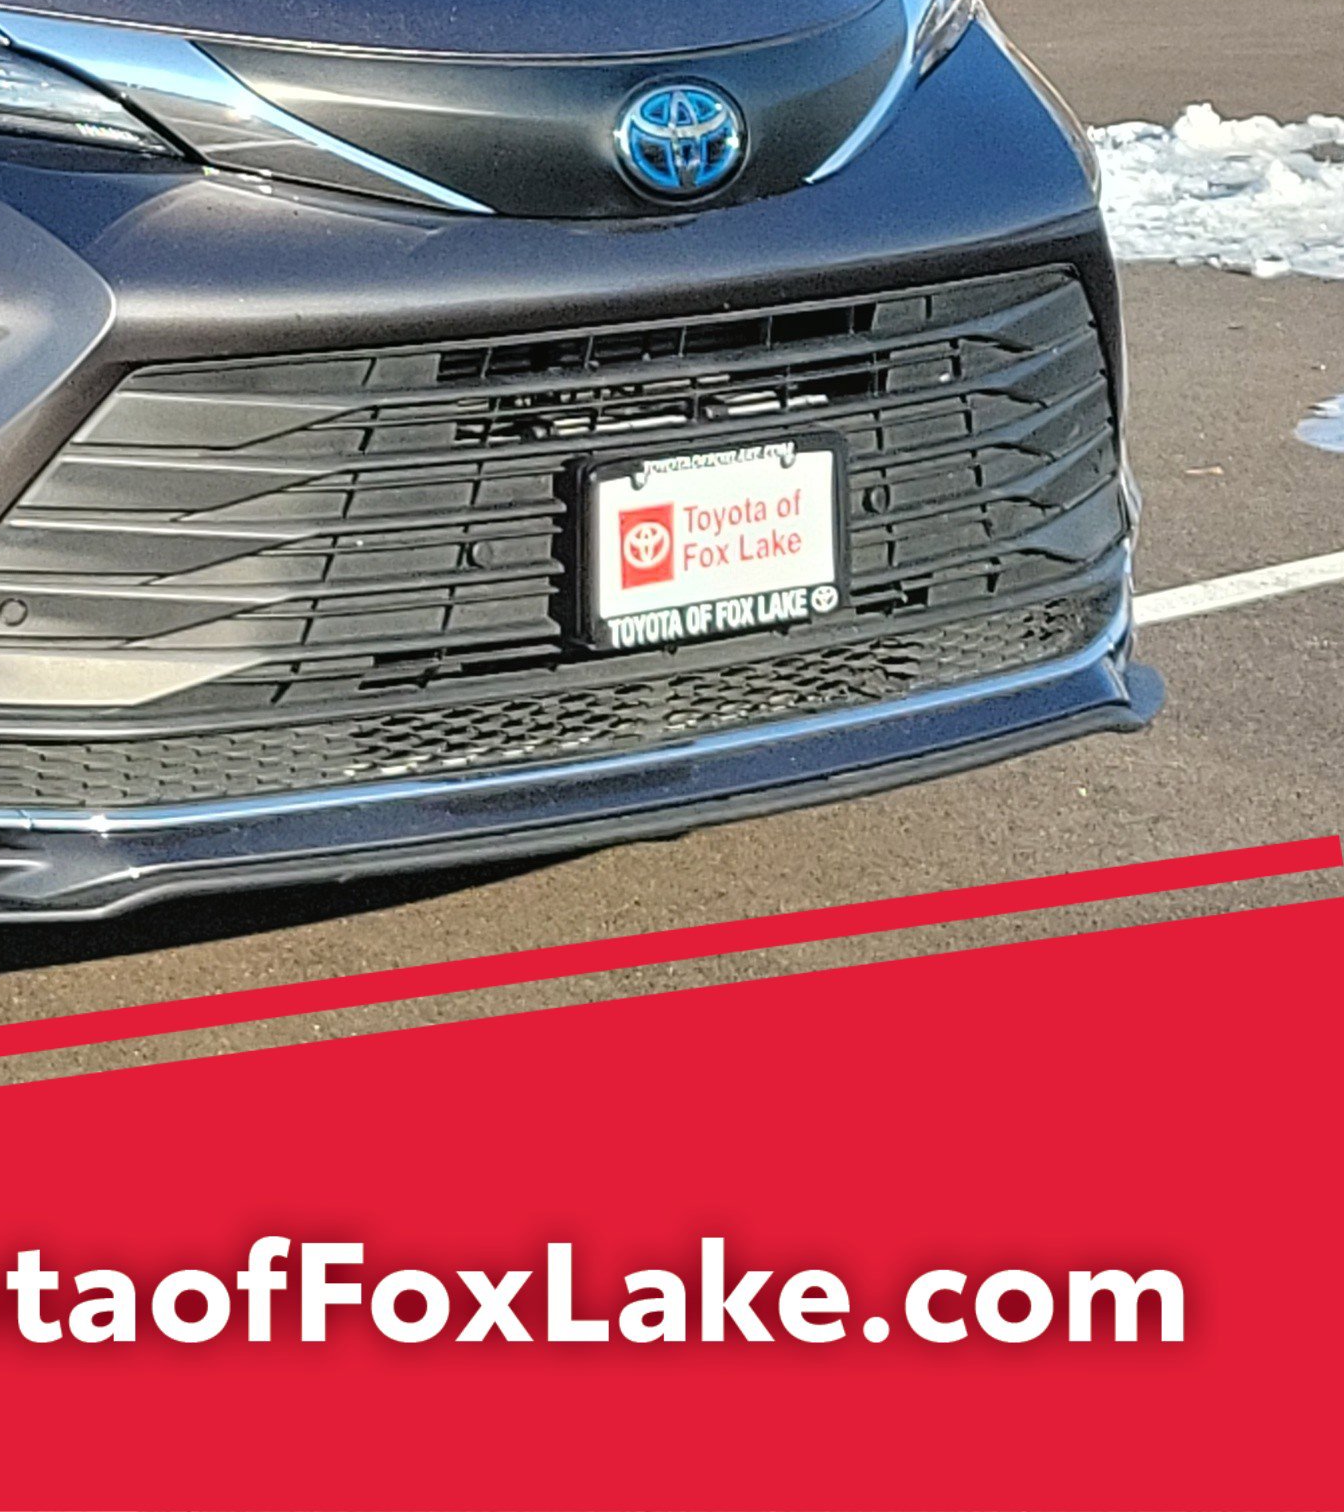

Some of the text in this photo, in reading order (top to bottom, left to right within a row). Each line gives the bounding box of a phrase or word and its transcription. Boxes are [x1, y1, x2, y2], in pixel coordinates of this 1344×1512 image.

[683, 489, 802, 536] Toyota of
[683, 529, 802, 572] Fox Lake
[608, 587, 809, 649] TOYOTA OF FOX LAKE
